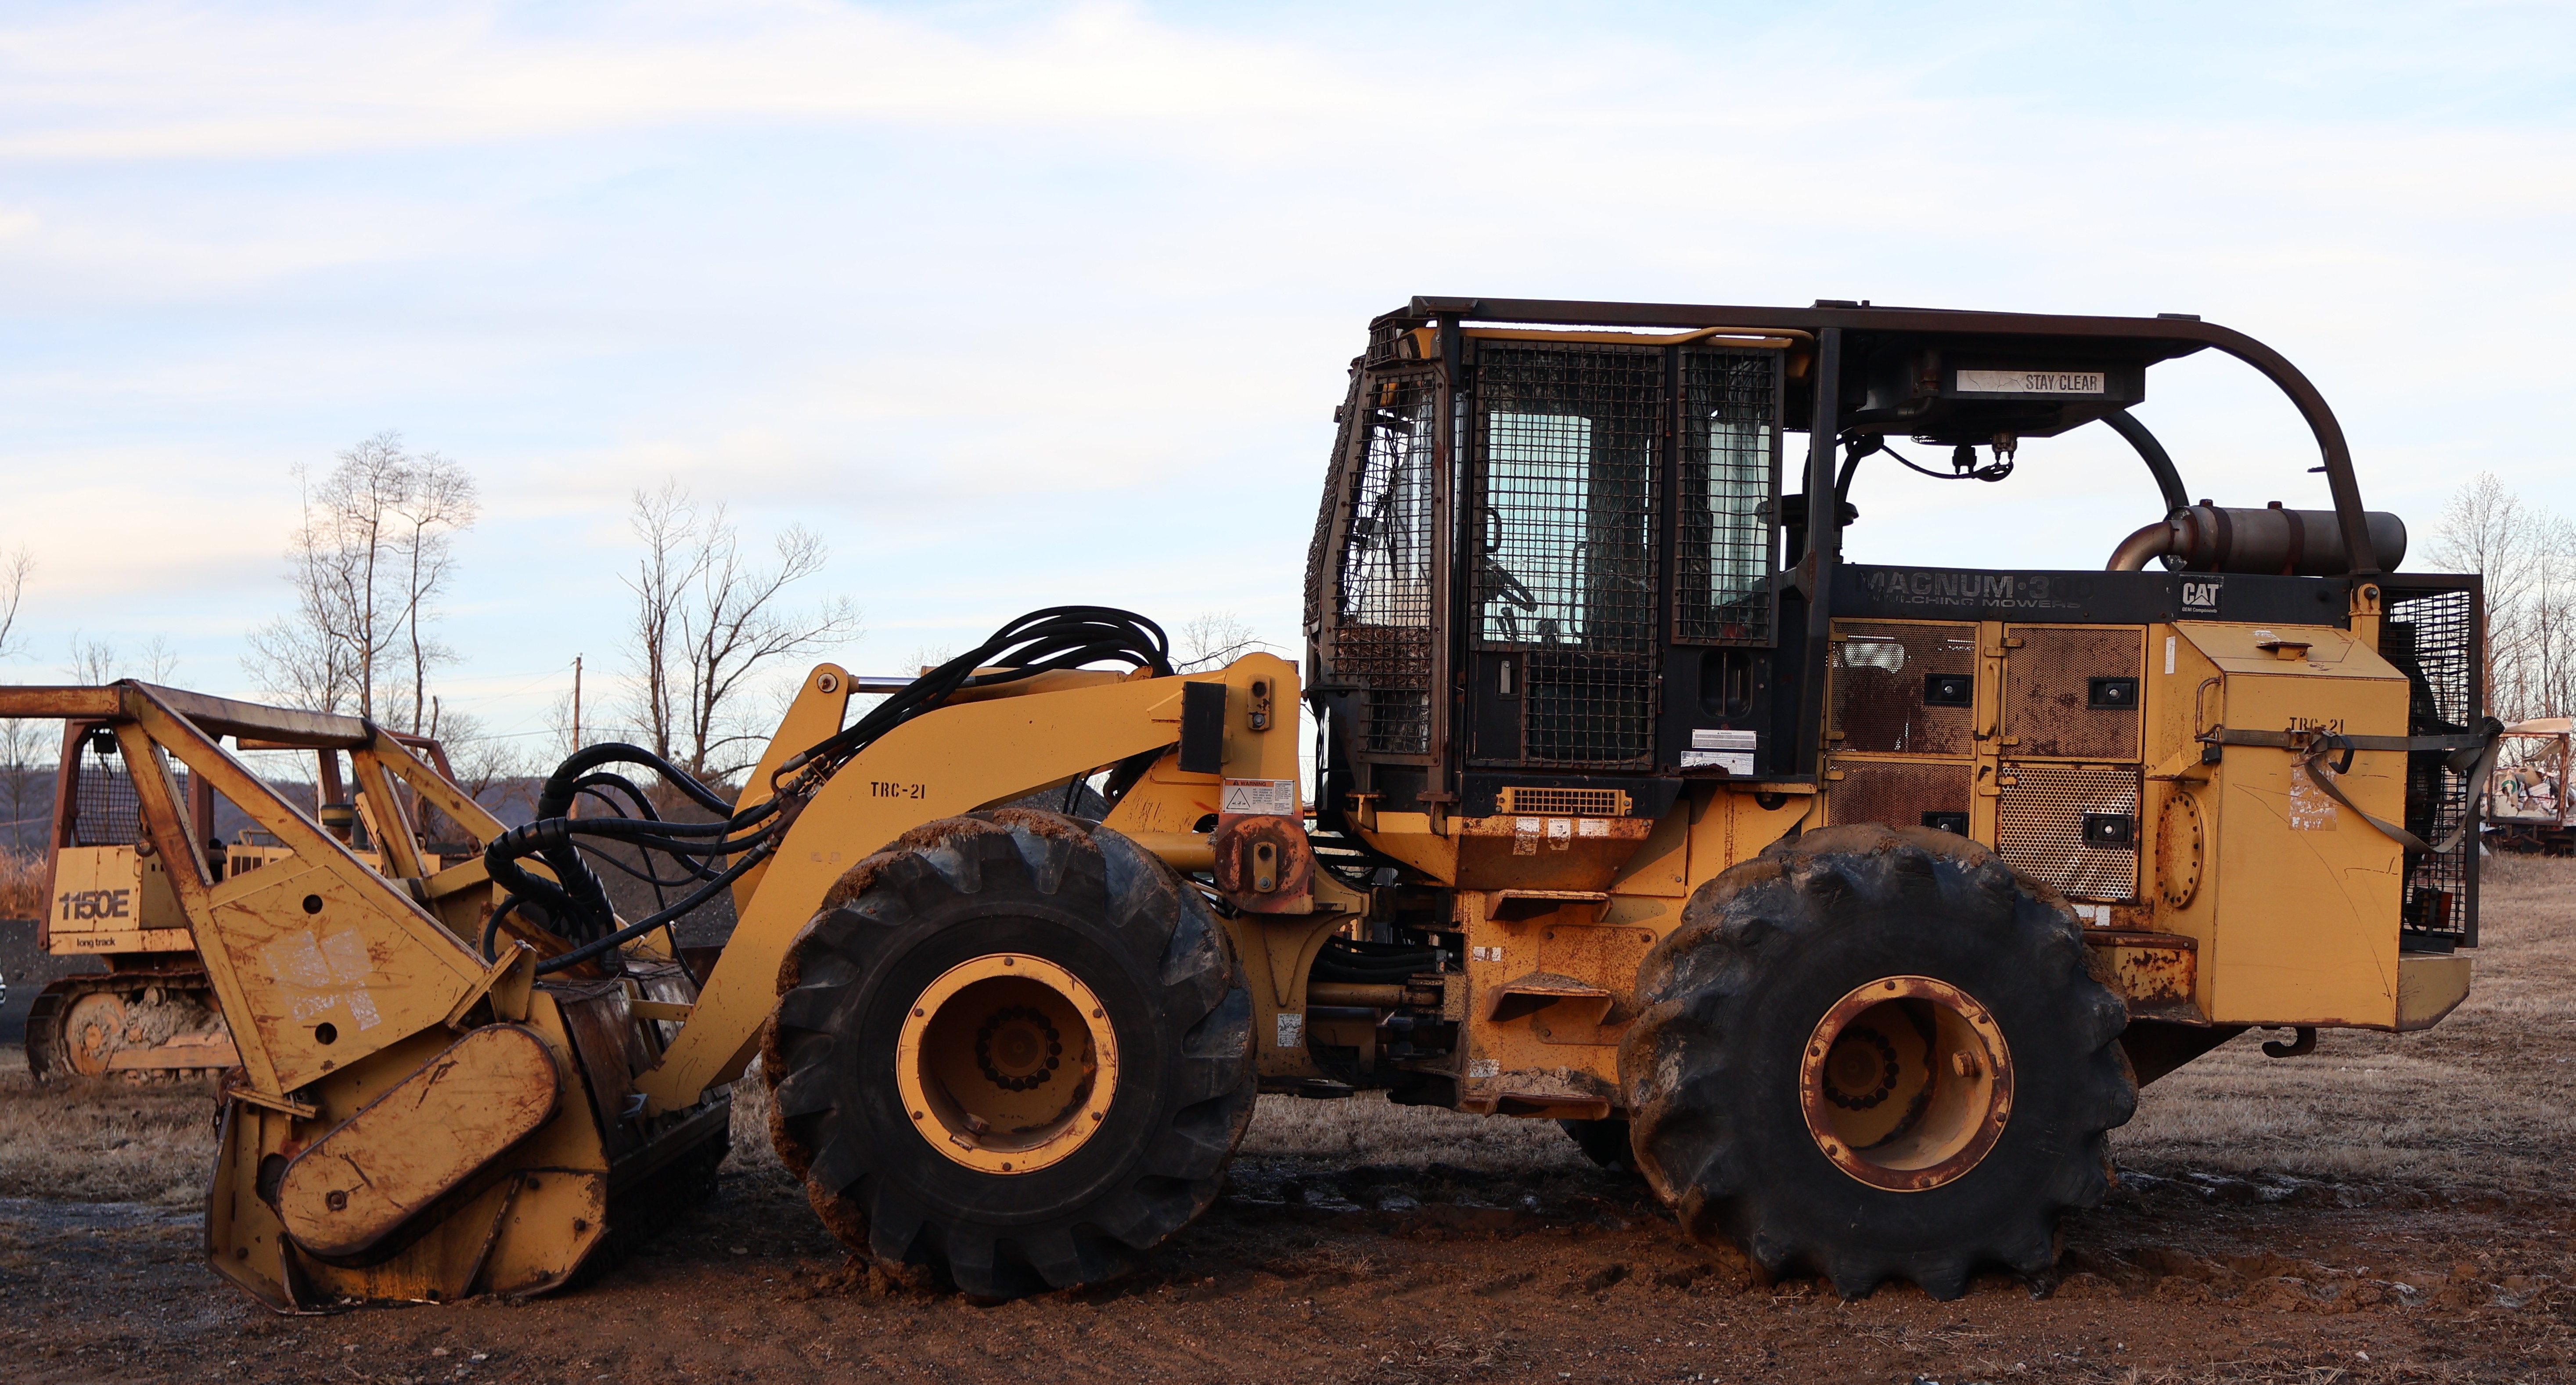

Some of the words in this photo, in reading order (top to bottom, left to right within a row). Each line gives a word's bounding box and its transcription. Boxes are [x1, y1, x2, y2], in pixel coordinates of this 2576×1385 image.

[2026, 374, 2054, 390] STAY
[2059, 375, 2097, 390] CLEAR
[2182, 582, 2219, 606] CAT
[1982, 599, 2081, 608] MOWERS
[871, 782, 925, 799] TRC-21
[58, 889, 130, 920] 1150E
[77, 938, 94, 949] long
[95, 937, 115, 946] track
